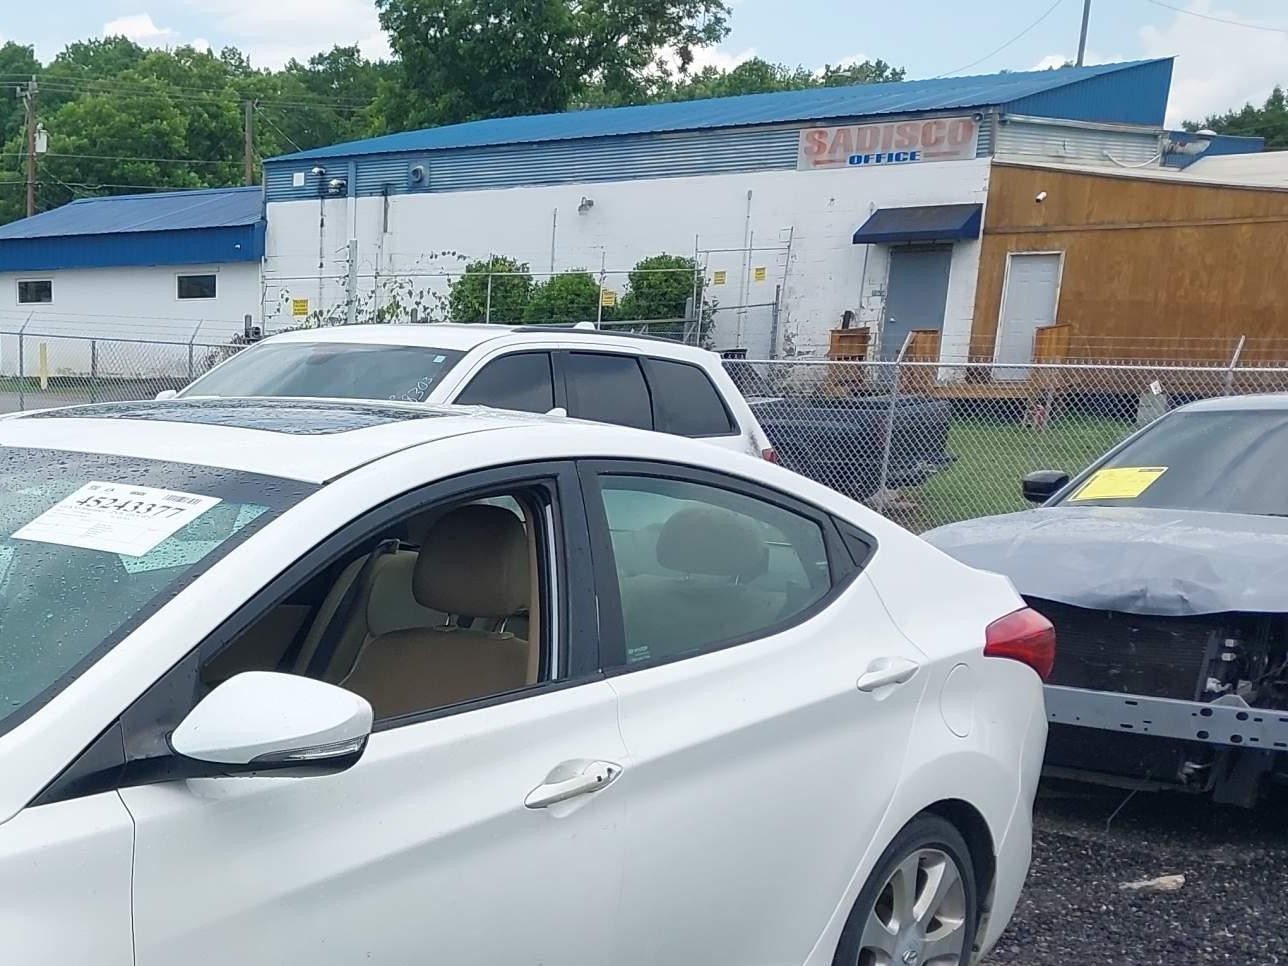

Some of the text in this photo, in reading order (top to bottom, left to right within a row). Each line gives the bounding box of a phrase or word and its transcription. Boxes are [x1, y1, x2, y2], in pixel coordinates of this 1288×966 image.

[804, 118, 974, 157] SADISCO
[848, 150, 921, 166] OFFICE
[76, 495, 187, 519] 45243377
